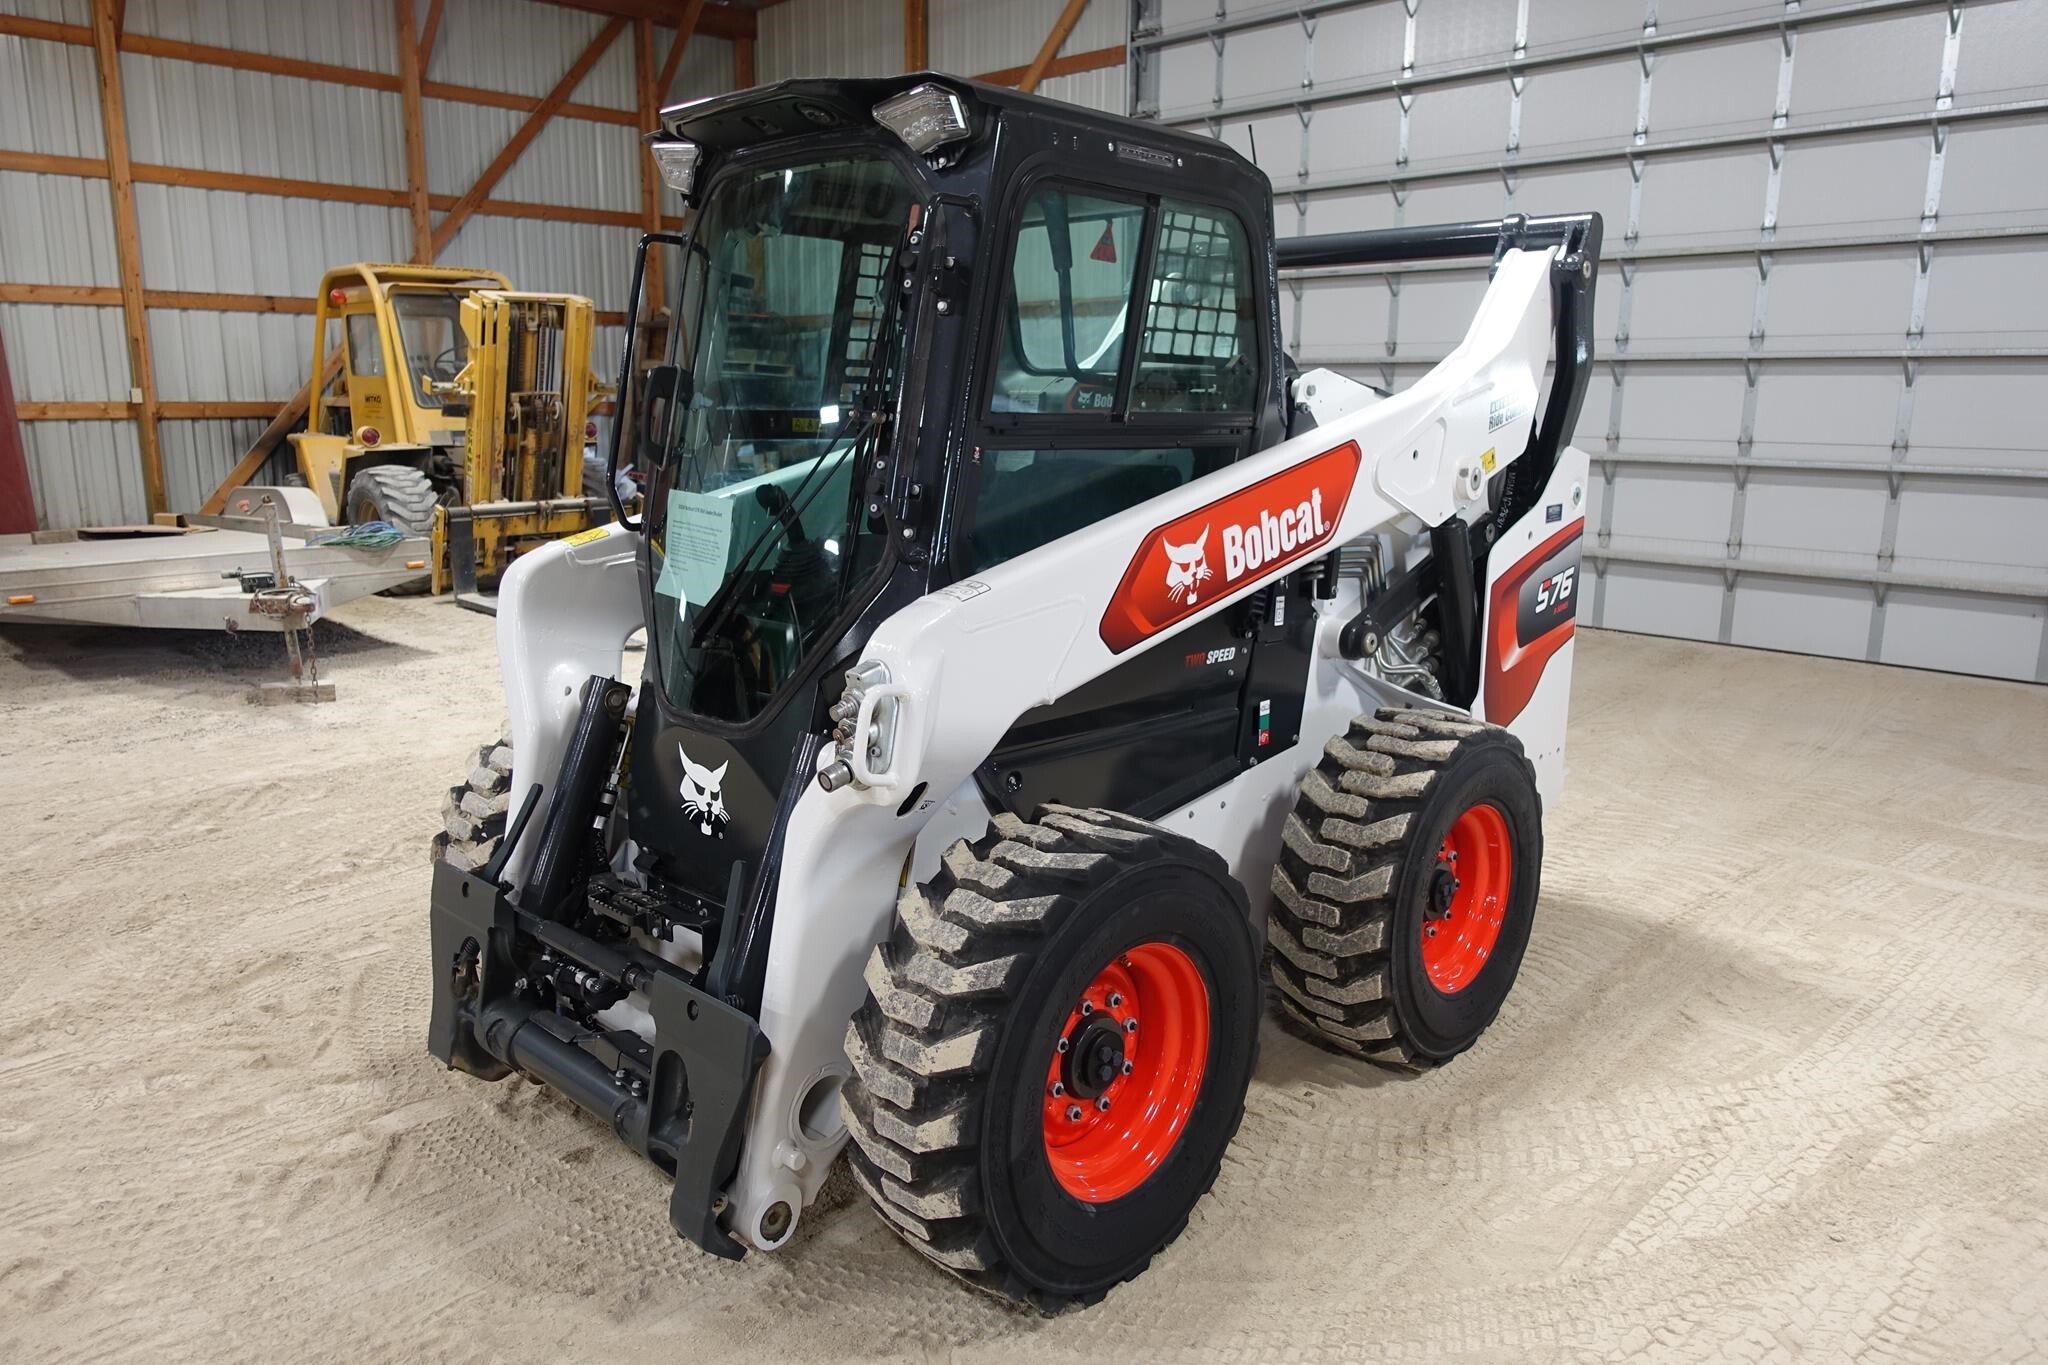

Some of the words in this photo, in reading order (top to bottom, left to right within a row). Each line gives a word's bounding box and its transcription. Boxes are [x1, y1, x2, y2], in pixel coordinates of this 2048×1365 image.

[1222, 487, 1325, 582] Bobcat
[1535, 566, 1576, 614] S76
[1206, 647, 1236, 665] SPEED
